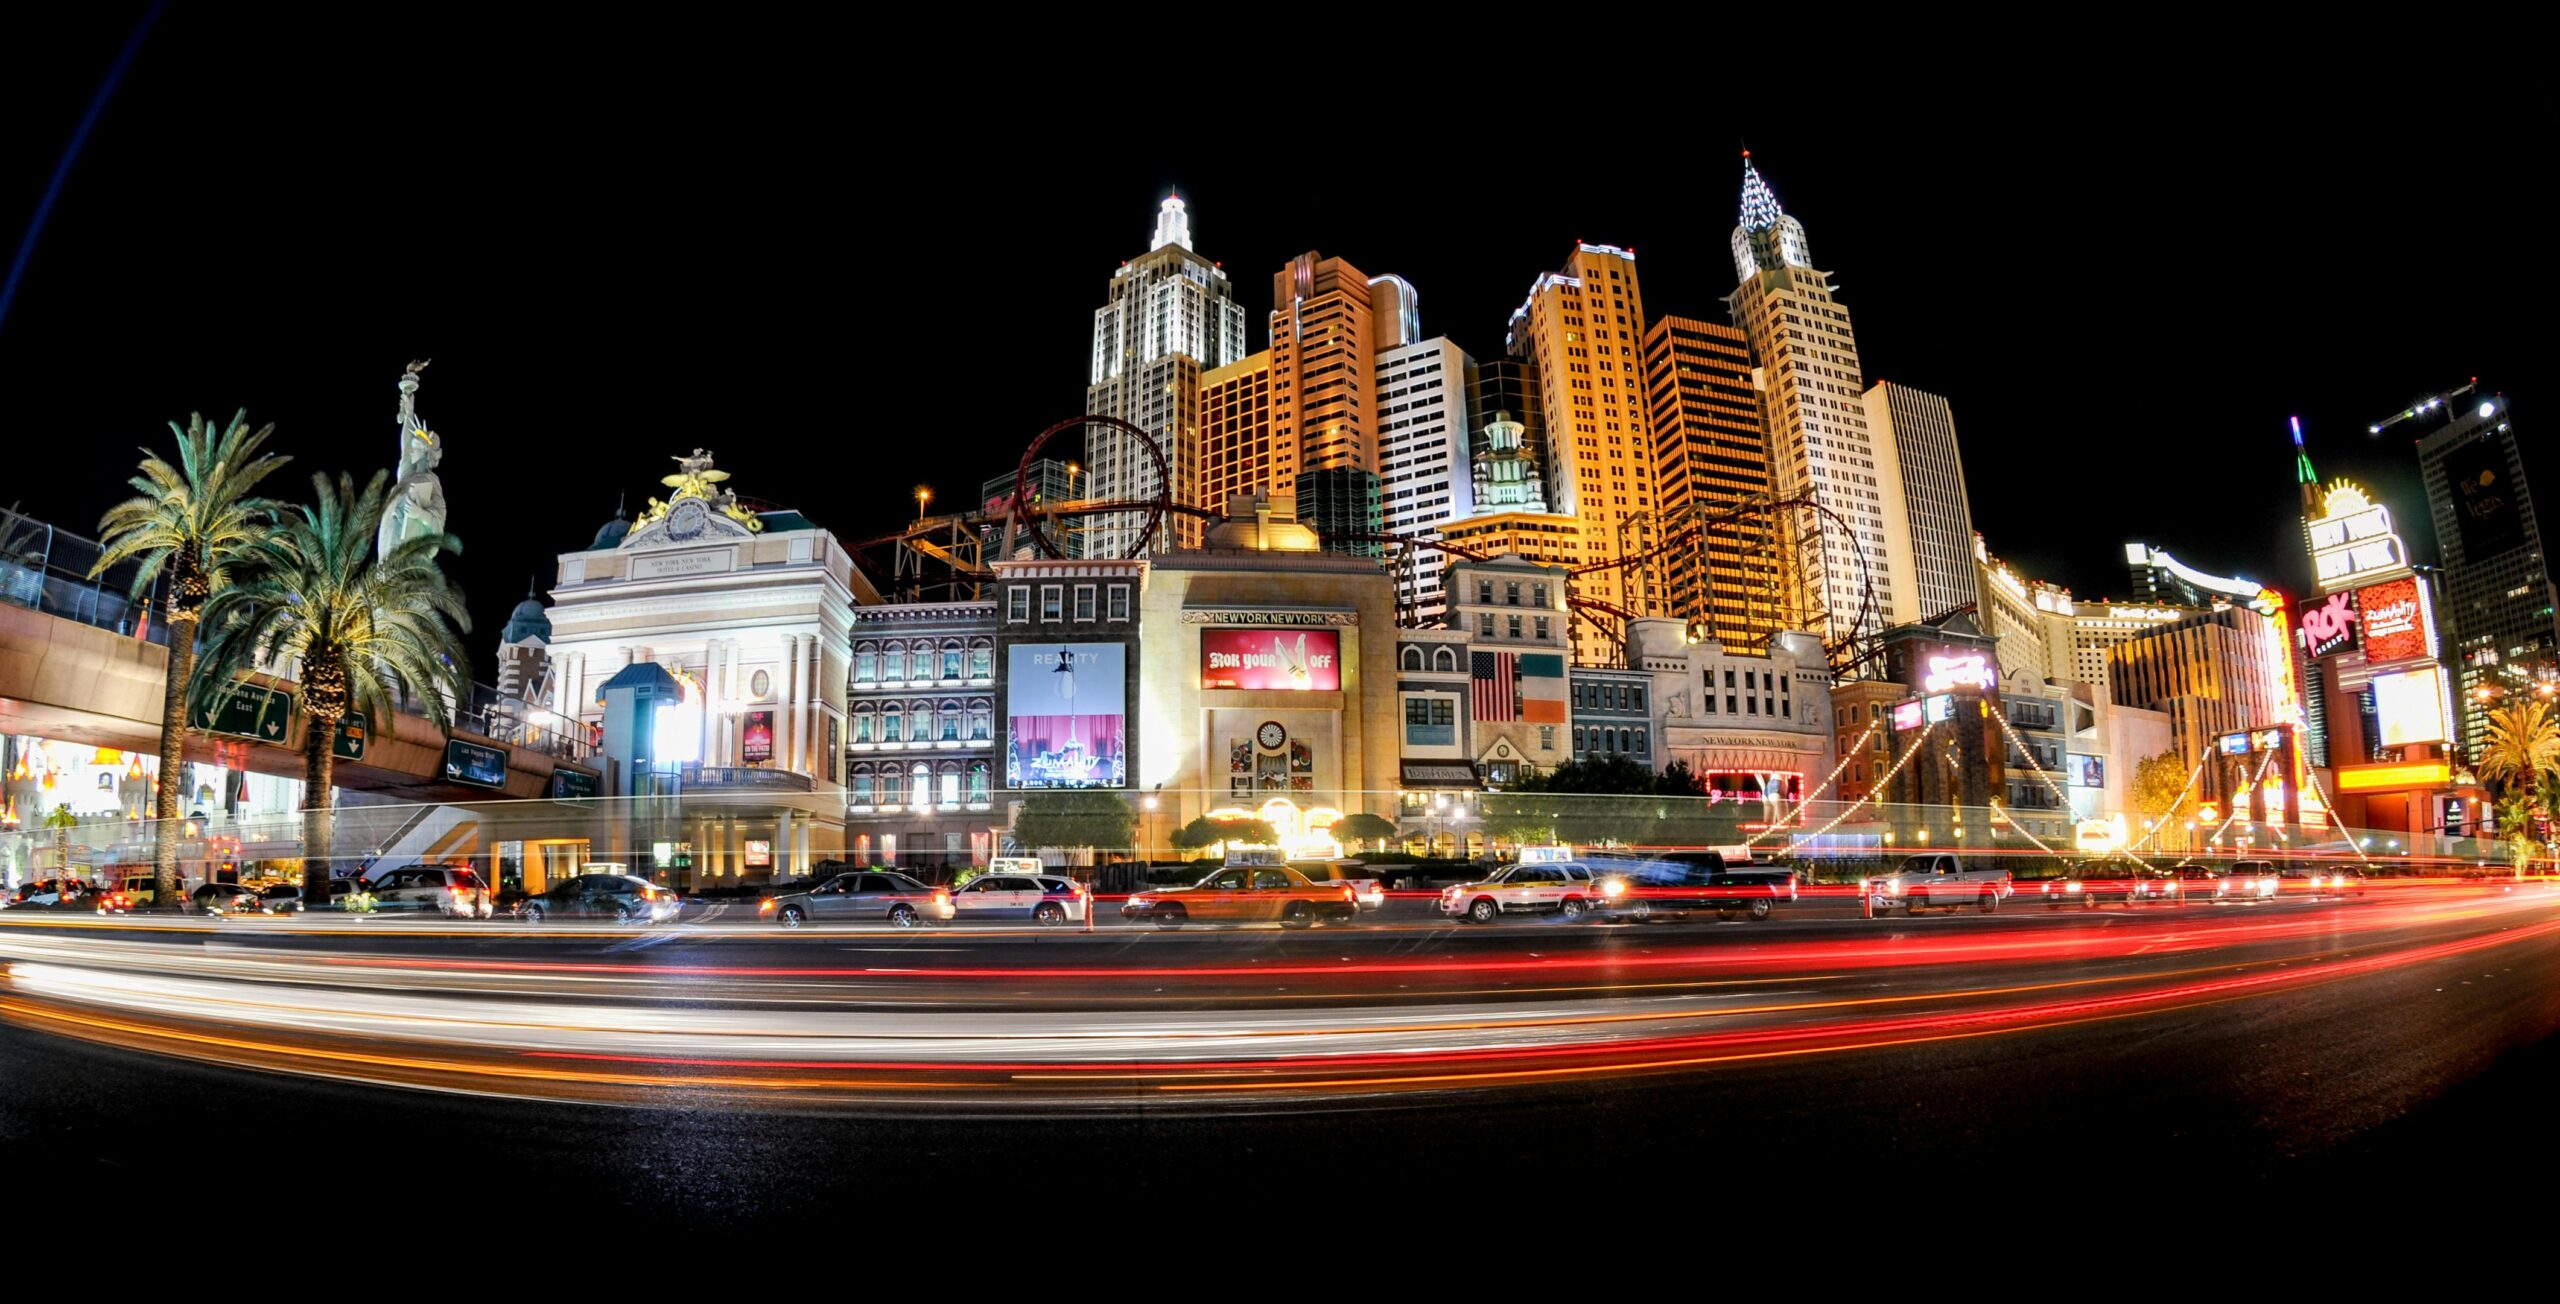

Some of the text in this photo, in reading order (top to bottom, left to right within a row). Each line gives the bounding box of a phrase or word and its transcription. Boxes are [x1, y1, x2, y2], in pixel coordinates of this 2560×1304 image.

[2309, 520, 2345, 550] NEW
[2315, 550, 2350, 580] NEW
[2302, 591, 2356, 658] ROK
[1033, 653, 1099, 665] REALITY
[235, 701, 253, 712] East
